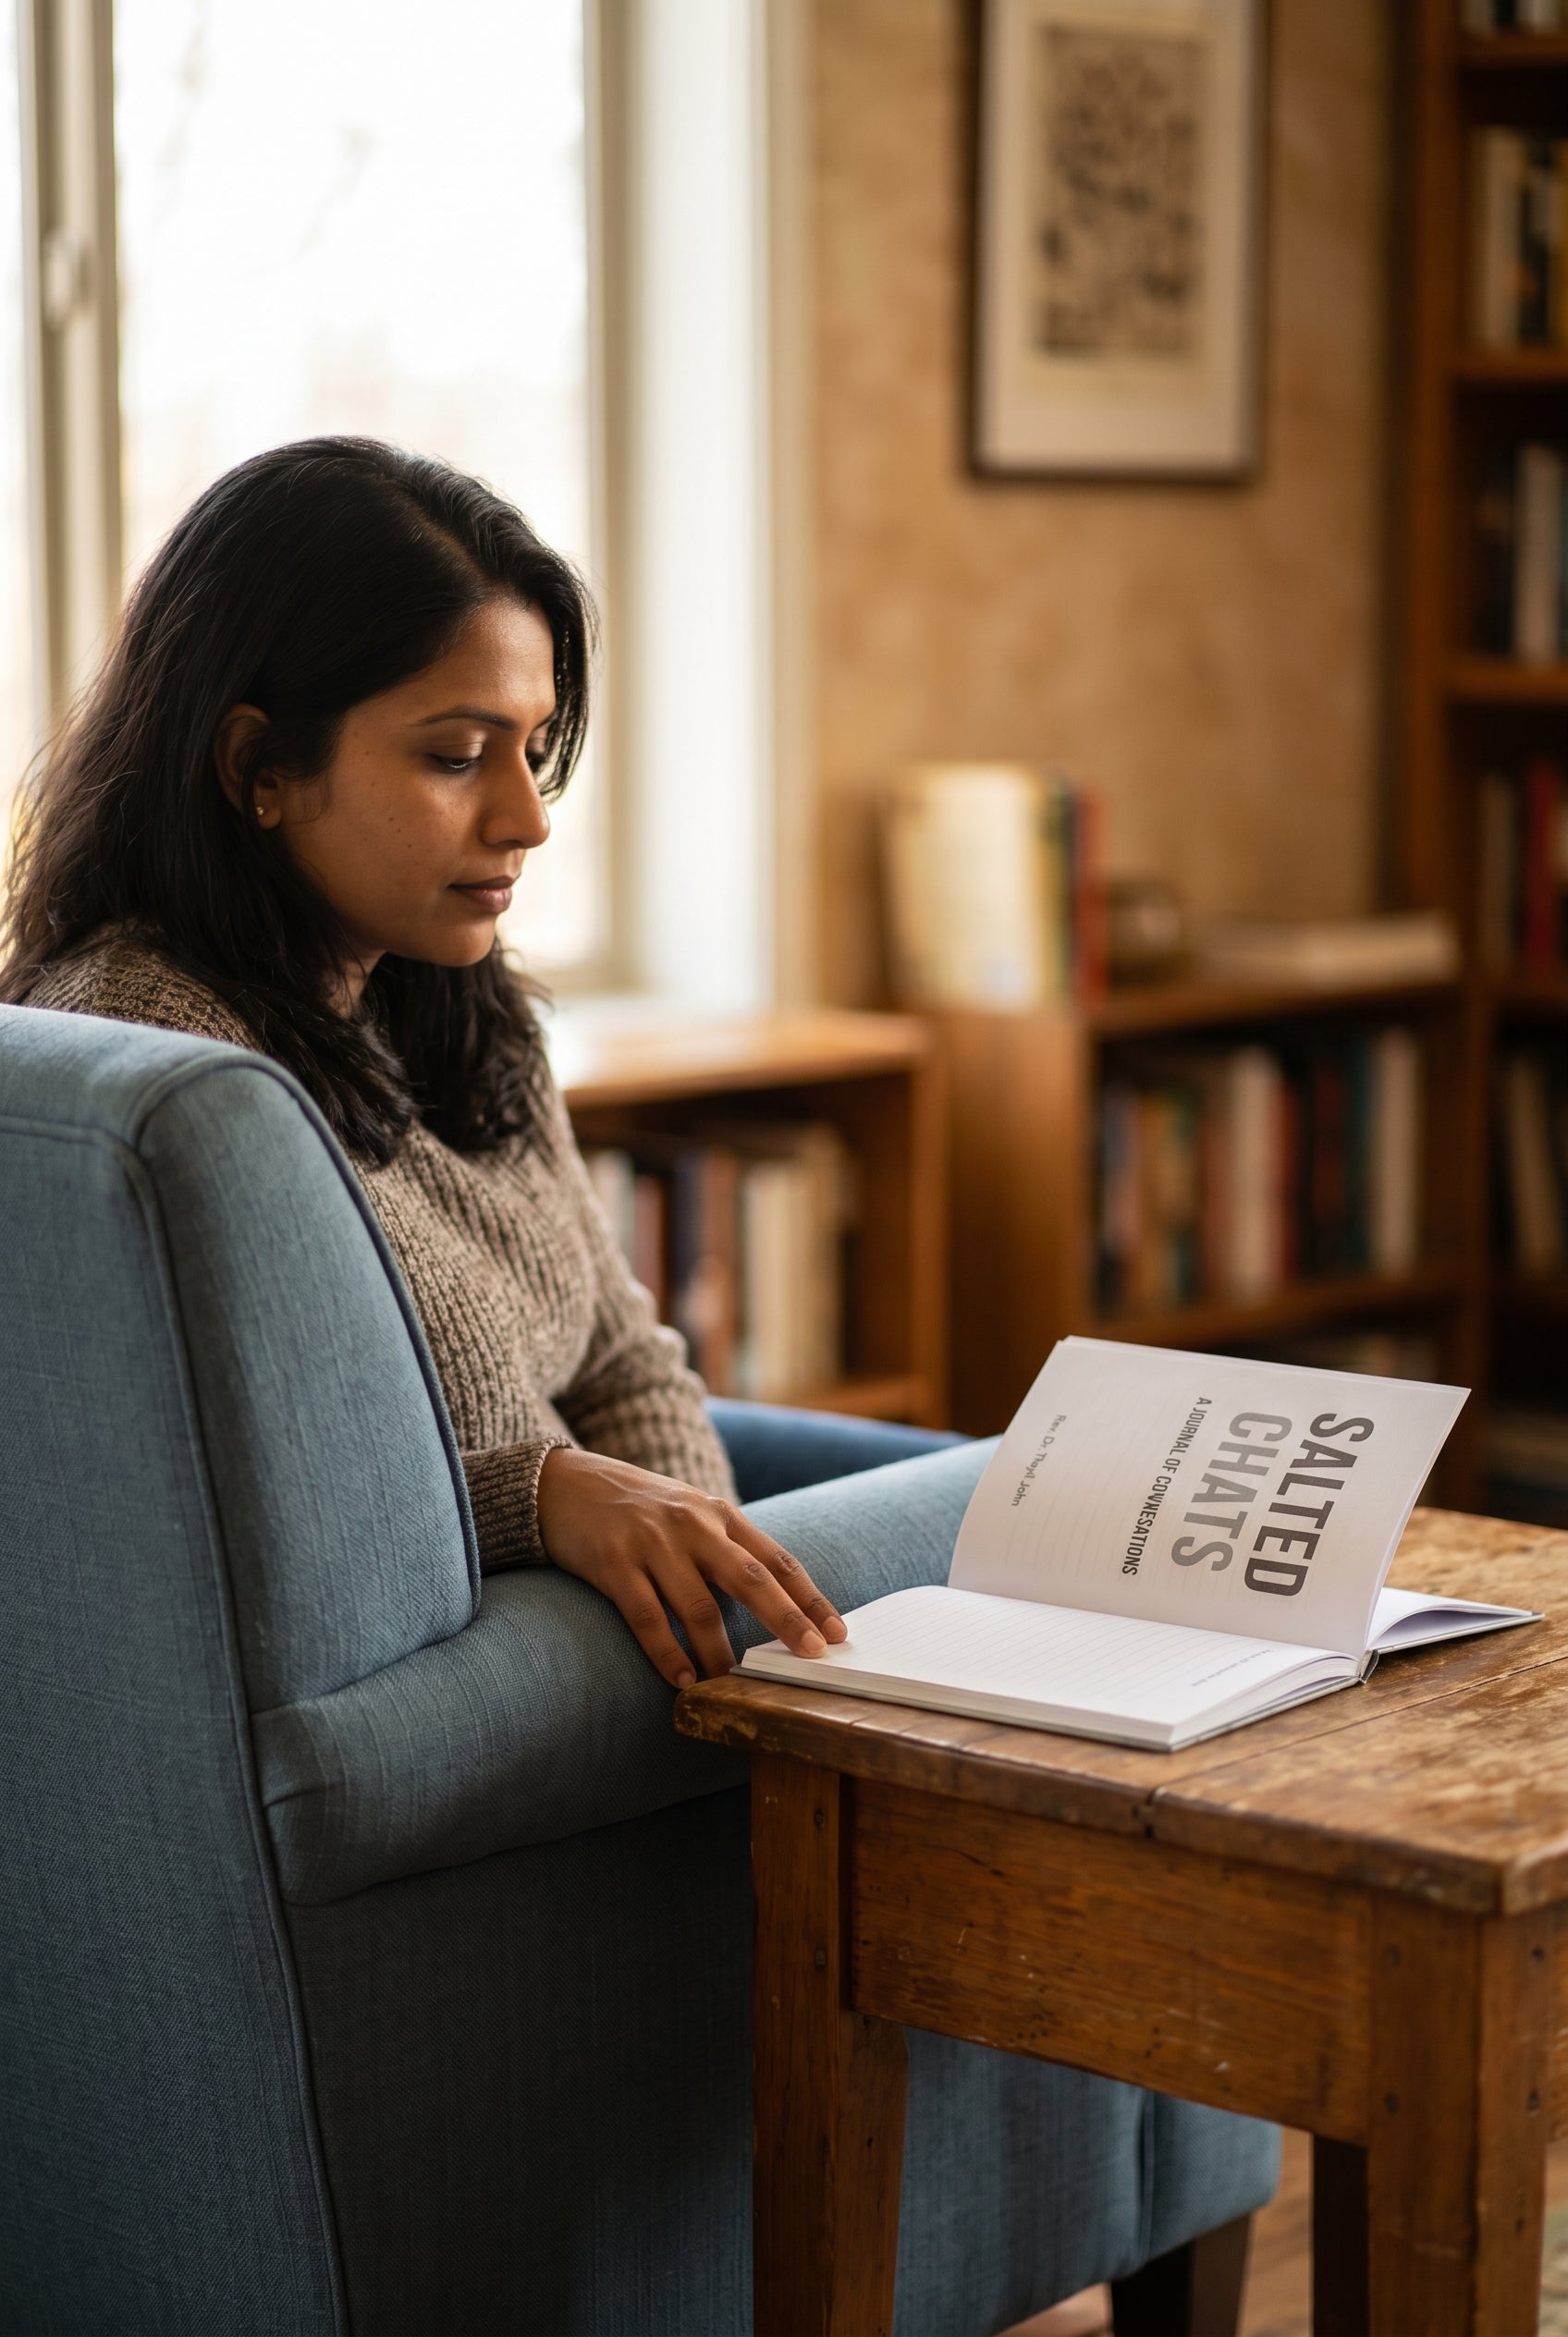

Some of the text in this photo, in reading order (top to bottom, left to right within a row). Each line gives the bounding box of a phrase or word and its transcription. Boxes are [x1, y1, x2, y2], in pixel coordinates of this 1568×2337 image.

[1195, 1397, 1212, 1405] A
[1169, 1407, 1207, 1456] JOURNAL
[1162, 1458, 1181, 1474] OF
[1011, 1480, 1030, 1507] John
[1170, 1412, 1292, 1572] CHATS
[1243, 1413, 1375, 1597] SALTED
